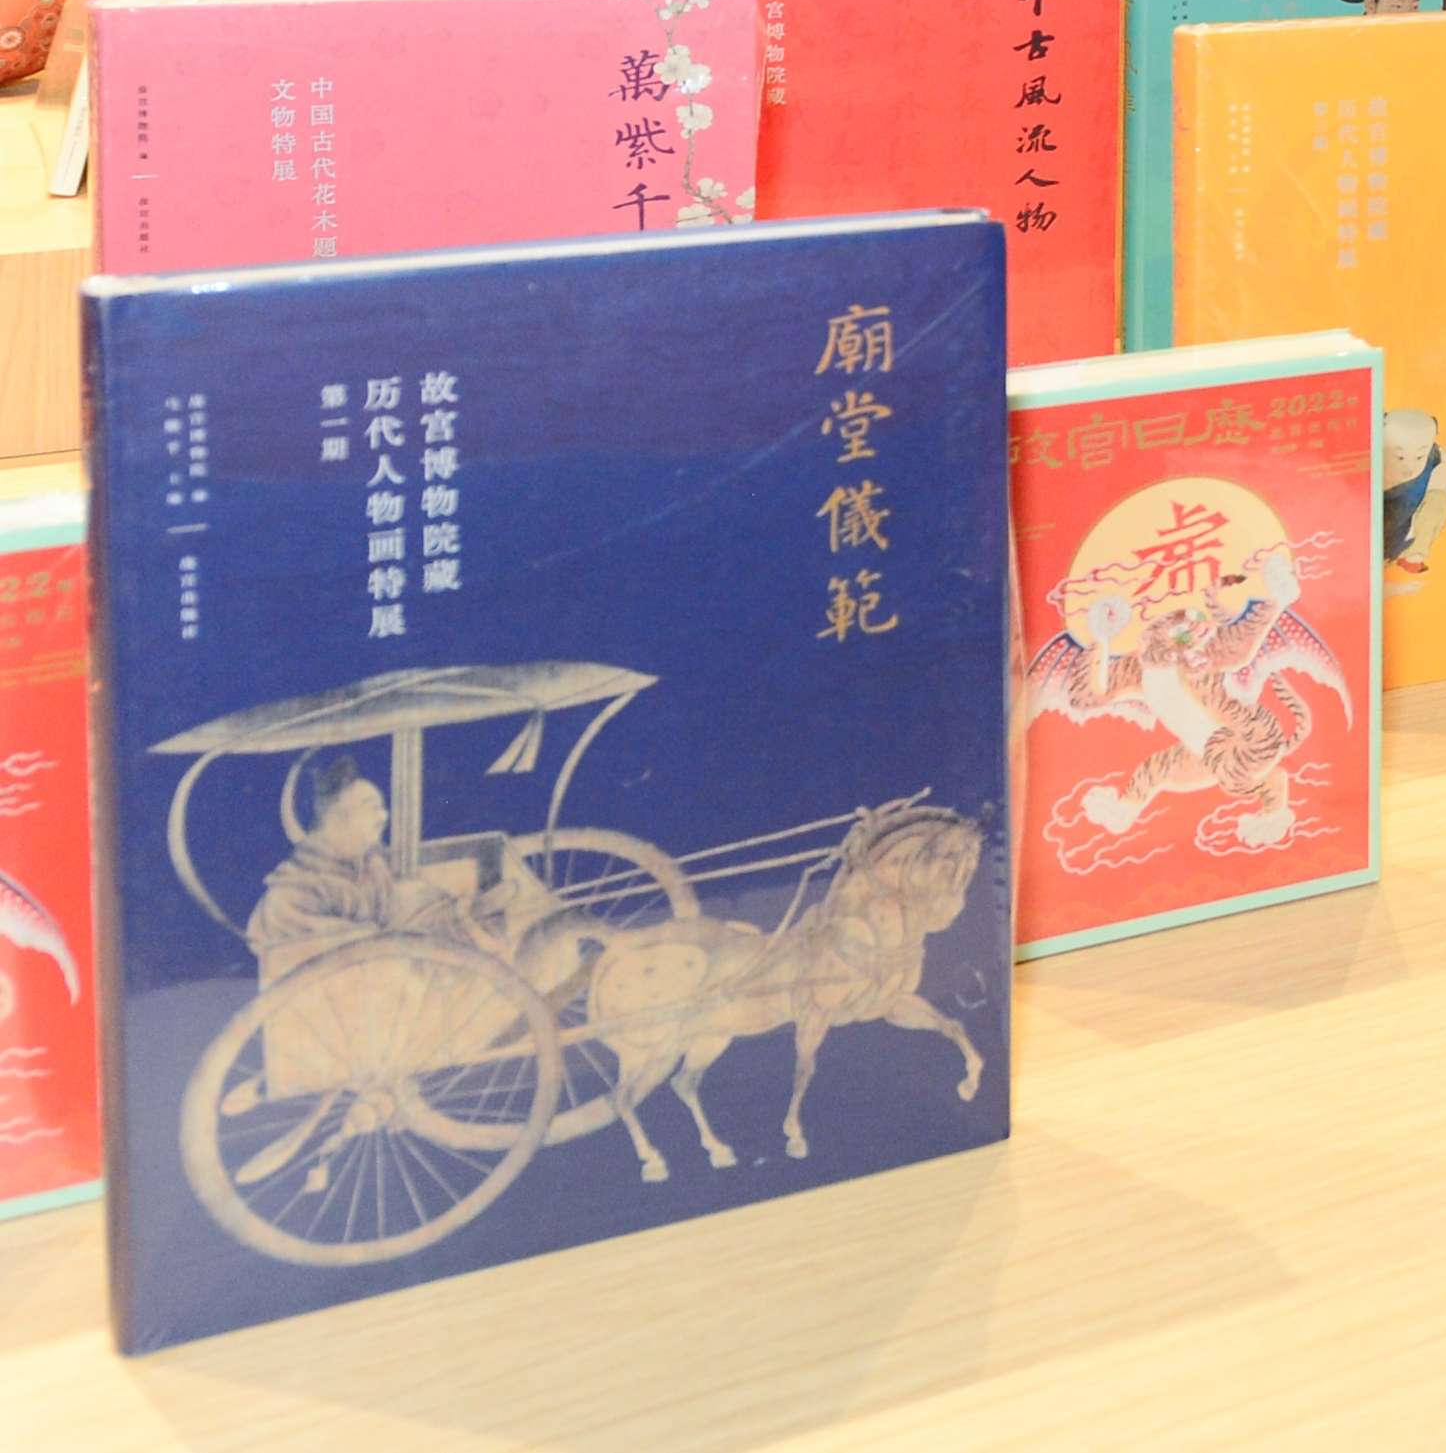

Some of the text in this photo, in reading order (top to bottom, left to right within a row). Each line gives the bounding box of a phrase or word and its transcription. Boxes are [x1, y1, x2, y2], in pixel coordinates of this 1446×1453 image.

[271, 79, 297, 182] 文物特展
[310, 76, 338, 258] 中国古代花木题
[320, 384, 349, 462] 第一期
[363, 376, 406, 639] 历代人物画特展
[420, 371, 462, 594] 故宫博物院藏
[815, 304, 898, 642] 廟堂儀範
